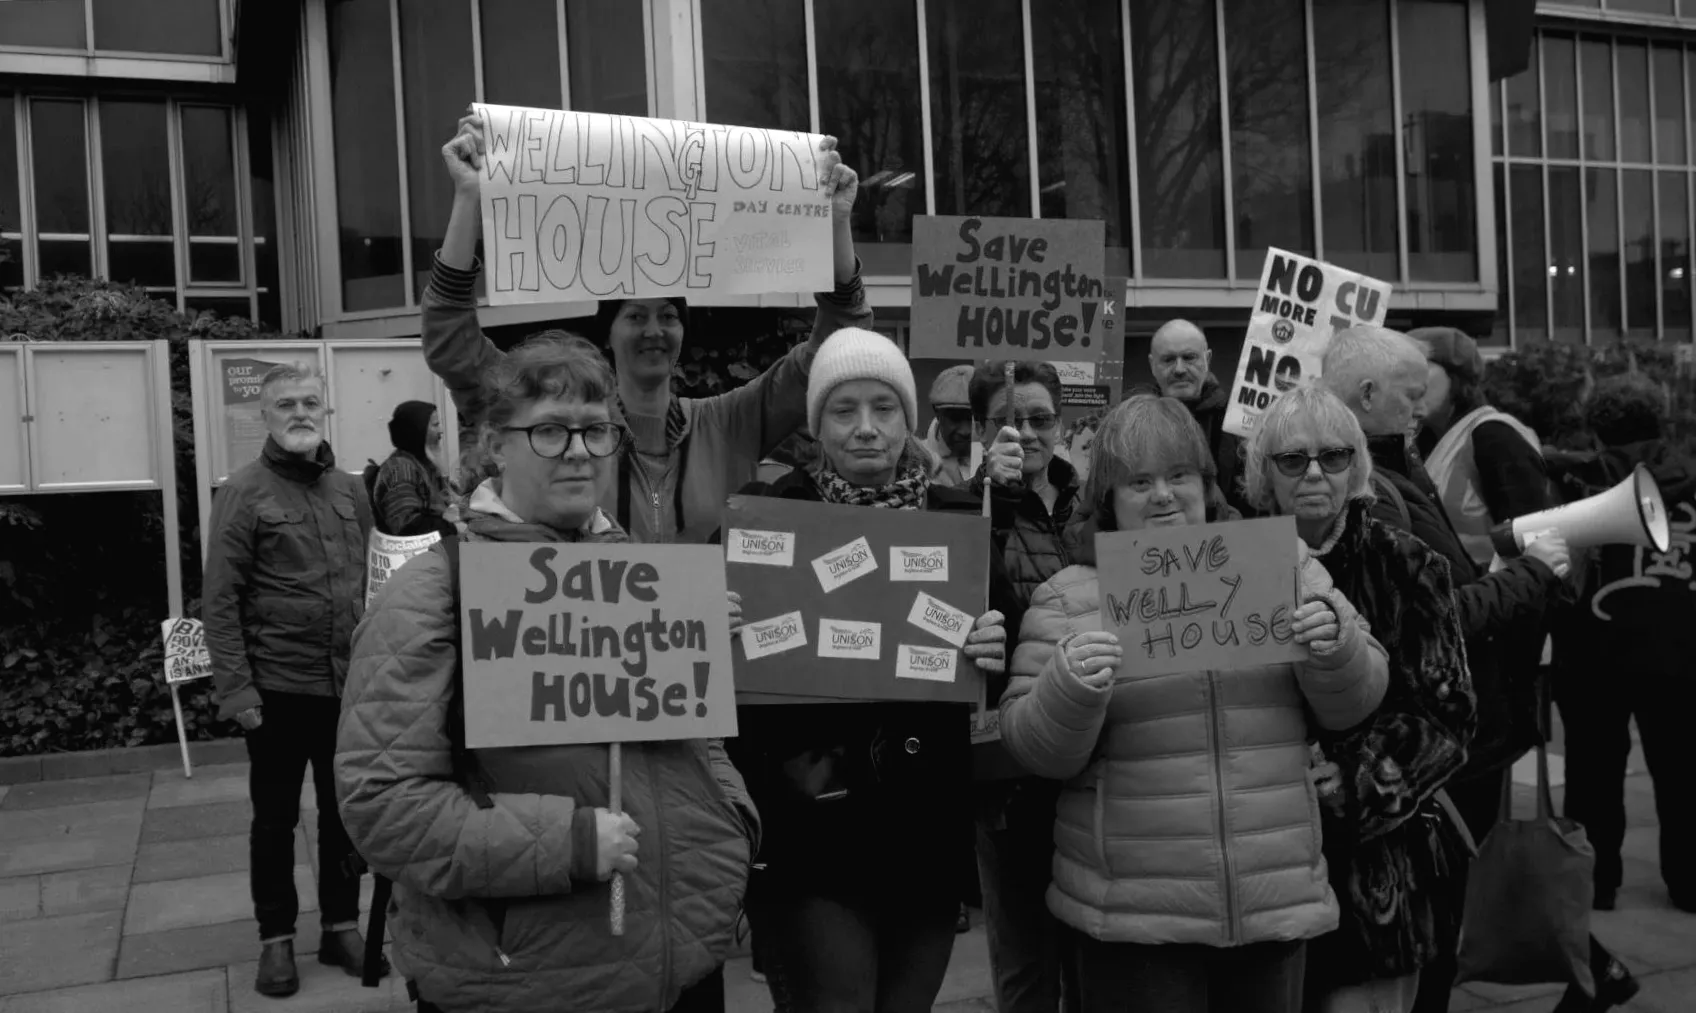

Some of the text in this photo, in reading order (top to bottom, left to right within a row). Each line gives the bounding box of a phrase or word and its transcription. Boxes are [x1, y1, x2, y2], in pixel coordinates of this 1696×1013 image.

[479, 107, 819, 200] WELLINGTON
[733, 200, 830, 218] DAY CENTRE
[491, 194, 716, 296] HOUSE
[956, 218, 1049, 264] Save
[1267, 254, 1324, 303] NO
[1260, 294, 1318, 327] MORE
[227, 366, 253, 377] our
[1244, 345, 1302, 392] NO
[242, 385, 261, 398] yo
[1238, 385, 1278, 410] MO
[742, 538, 785, 551] UNISON
[1140, 535, 1230, 577] SAVE
[828, 548, 869, 575] UNISON
[903, 556, 943, 569] UNISON
[524, 546, 660, 604] Save
[1107, 574, 1242, 625] WELLY
[924, 606, 963, 632] UNISON
[755, 623, 798, 643] UNISON
[832, 633, 873, 646] UNISON
[909, 655, 950, 669] UNISON
